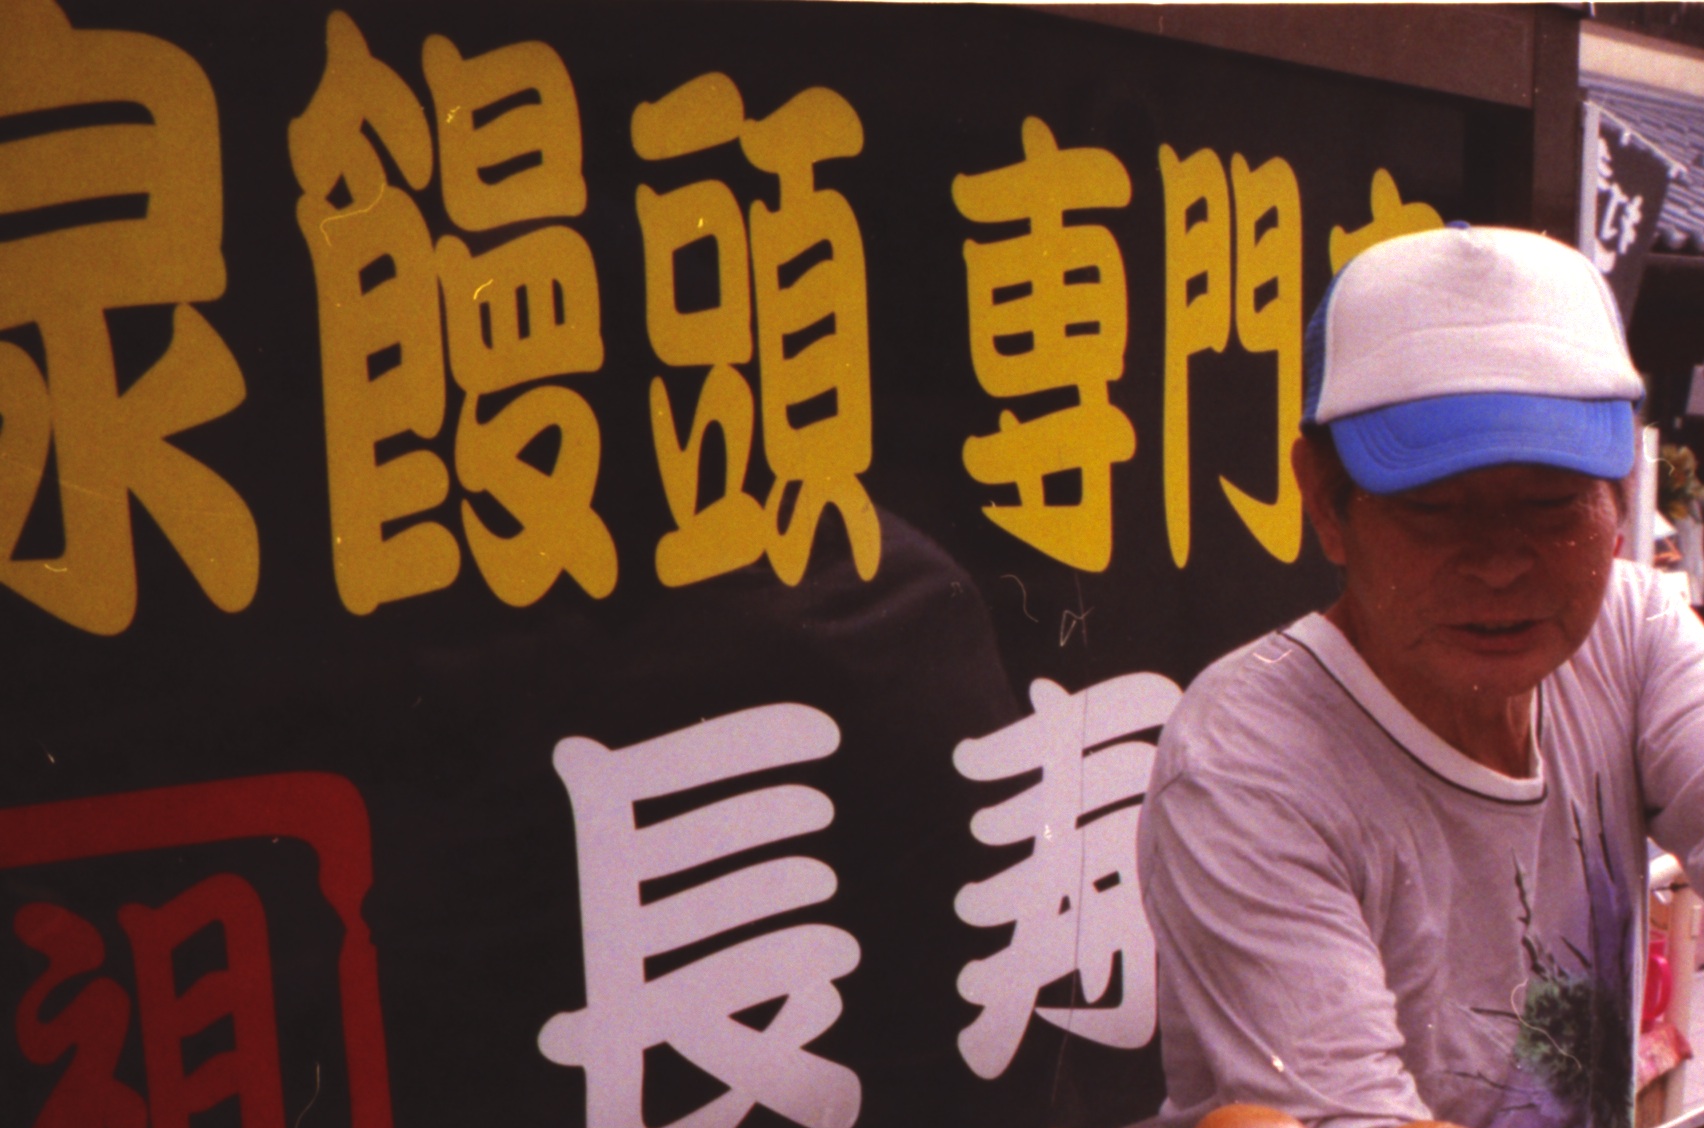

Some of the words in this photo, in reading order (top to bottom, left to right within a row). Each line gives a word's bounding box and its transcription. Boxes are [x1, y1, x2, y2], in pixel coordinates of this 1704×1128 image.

[0, 2, 1444, 637] 泉饅頭専門
